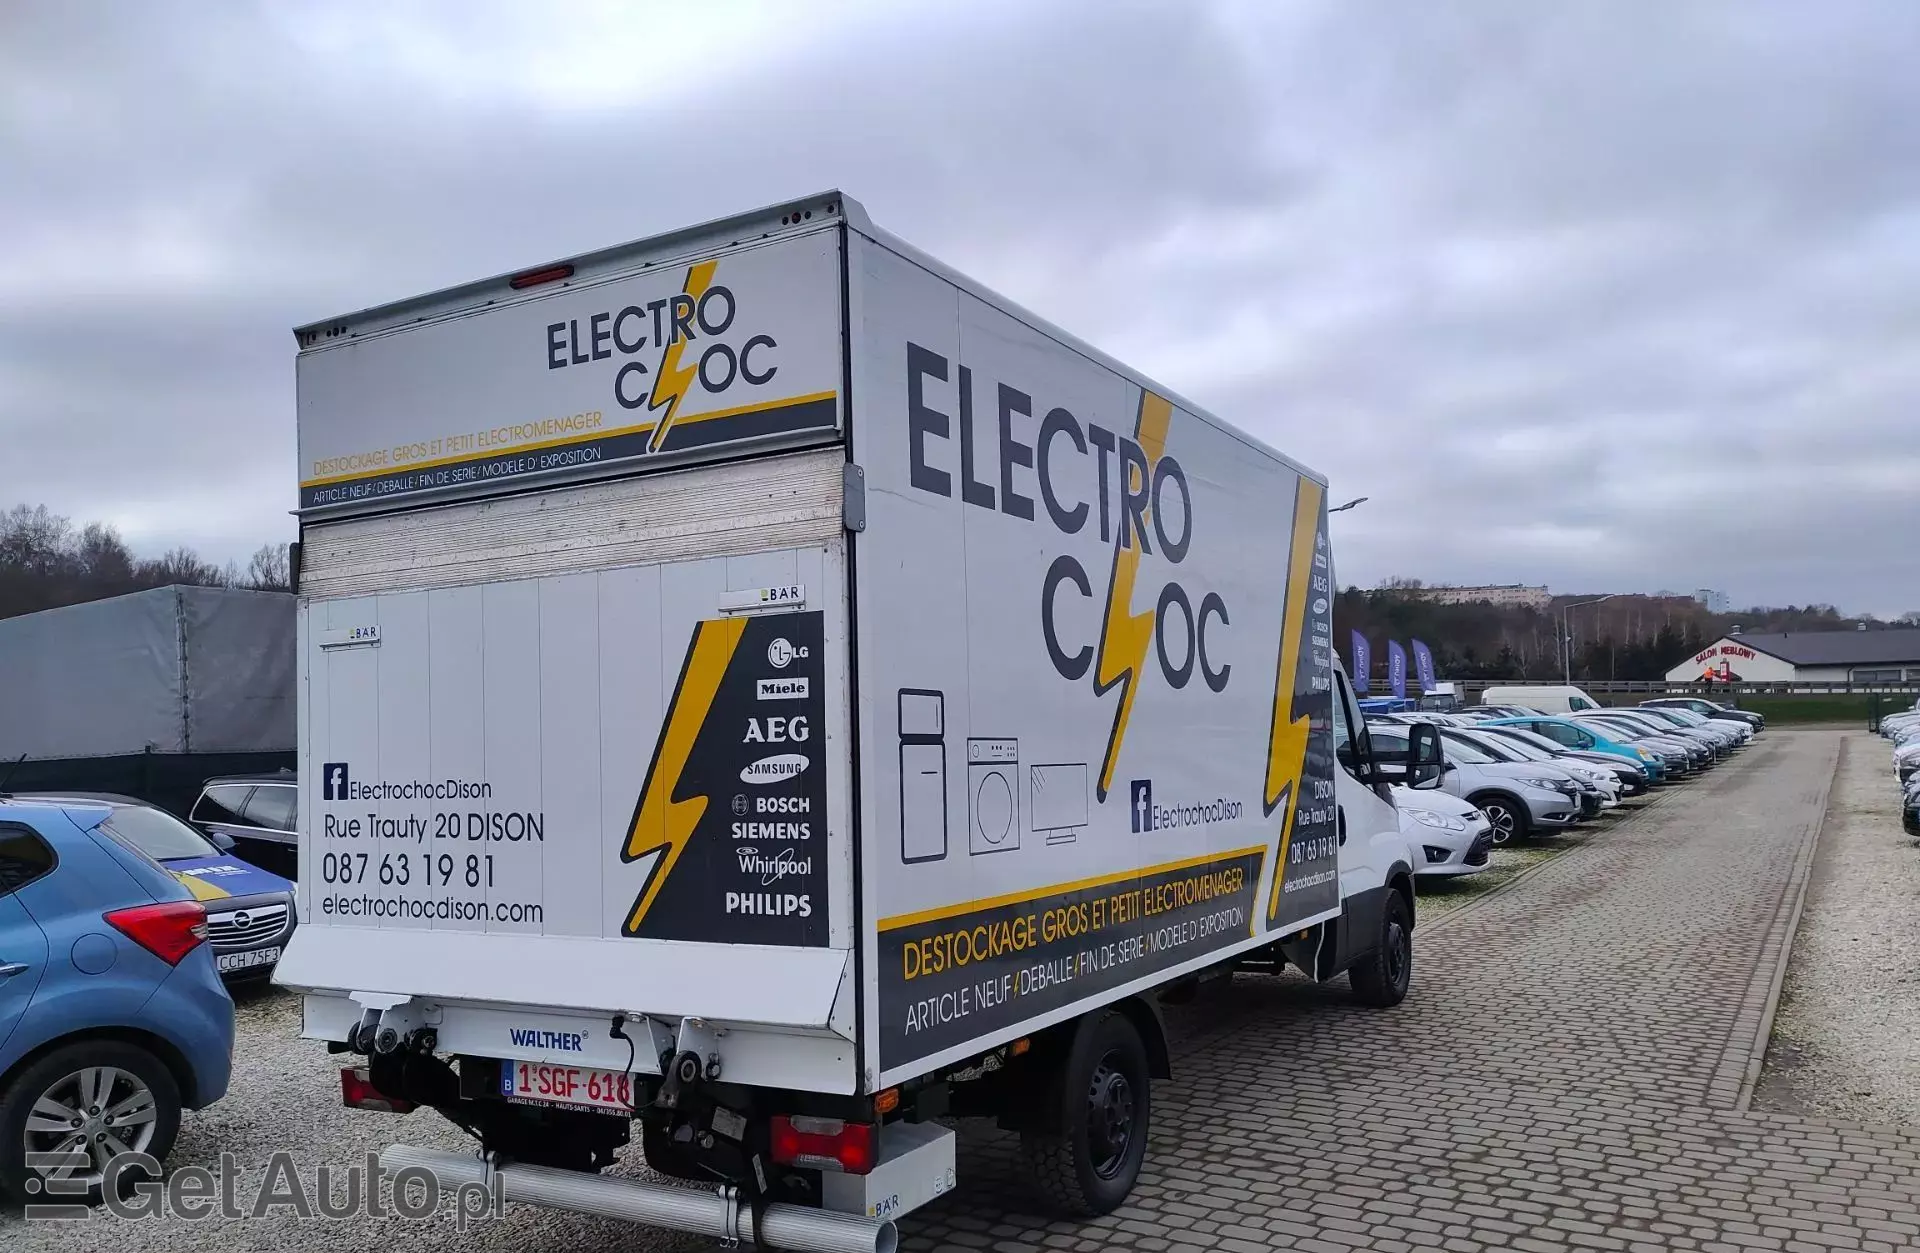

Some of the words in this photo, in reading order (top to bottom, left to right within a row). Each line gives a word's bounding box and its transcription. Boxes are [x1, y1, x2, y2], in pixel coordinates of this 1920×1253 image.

[547, 285, 735, 369] ELECTRO
[313, 450, 389, 476] DESTOCKAGE
[392, 442, 427, 462] GROS
[430, 439, 442, 455] ET
[447, 434, 474, 452] PETIT
[478, 411, 602, 446] ELECTROMENAGER
[907, 341, 1192, 564] ELECTRO
[313, 487, 347, 503] ARTICLE
[437, 470, 449, 484] DE
[541, 446, 601, 468] EXPOSITION
[1313, 575, 1327, 592] AEG
[1695, 648, 1717, 665] SALON
[1721, 646, 1757, 661] MEBLOWY
[761, 683, 805, 694] Miele
[1312, 676, 1330, 691] PHILIPS
[742, 716, 810, 743] AEG
[748, 764, 802, 774] SAMSUNG
[350, 779, 492, 800] ElectrochocDison
[1314, 780, 1334, 800] DISON
[756, 797, 810, 813] BOSCH
[1153, 798, 1243, 831] ElectrochocDison
[1298, 809, 1310, 826] Rue
[1328, 805, 1335, 821] 20
[324, 814, 361, 838] Rue
[367, 813, 427, 844] Trauty
[435, 812, 461, 839] 20
[467, 812, 544, 841] DISON
[731, 822, 811, 839] SIEMENS
[1291, 842, 1306, 864] 087
[1307, 840, 1317, 861] 63
[1319, 837, 1327, 858] 19
[1328, 836, 1337, 856] 81
[322, 853, 368, 884] 087
[379, 853, 410, 885] 63
[423, 854, 454, 886] 19
[465, 854, 493, 887] 81
[738, 855, 811, 880] Whirlpool
[1284, 869, 1336, 893] electrochocdison.com
[322, 893, 544, 923] electrochocdison.com
[726, 892, 811, 917] PHILIPS
[903, 914, 1037, 981] DESTOCKAGE
[1042, 902, 1089, 943] GROS
[1092, 898, 1107, 930] ET
[1111, 891, 1141, 925] PETIT
[1144, 867, 1244, 916] ELECTROMENAGER
[220, 953, 246, 969] CCH
[905, 987, 970, 1036] ARTICLE
[1101, 943, 1115, 970] DE
[1200, 905, 1244, 938] EXPOSITION
[504, 1079, 512, 1091] B
[507, 1096, 528, 1105] GARAGE
